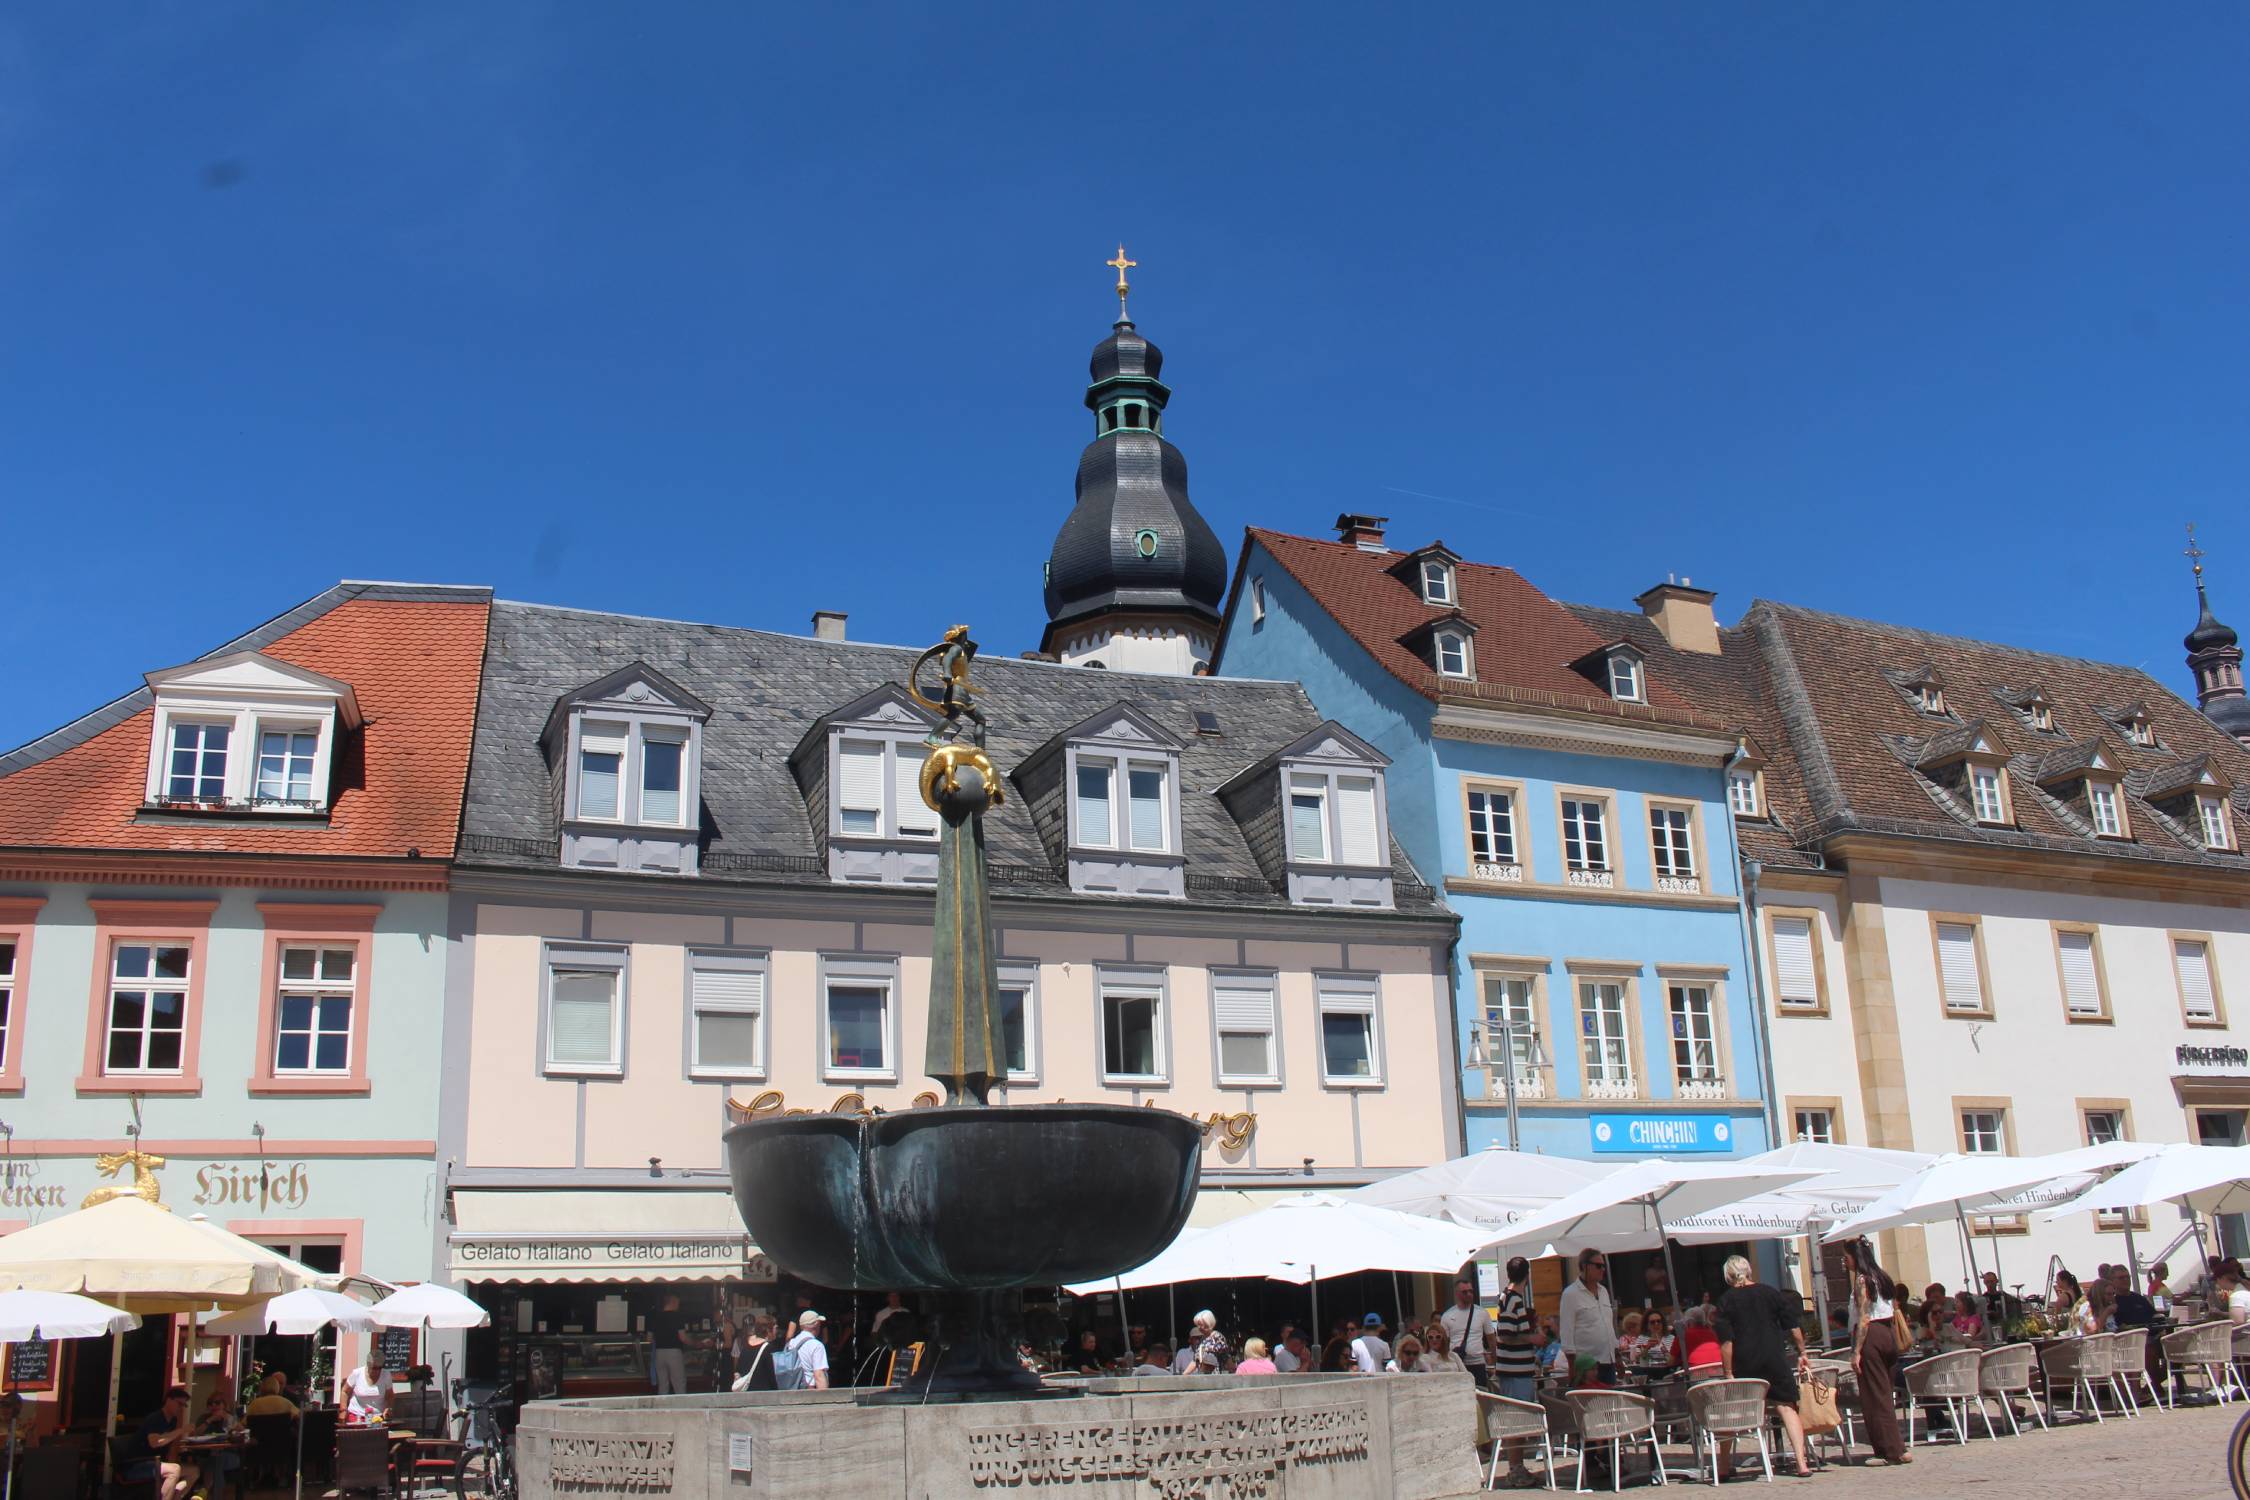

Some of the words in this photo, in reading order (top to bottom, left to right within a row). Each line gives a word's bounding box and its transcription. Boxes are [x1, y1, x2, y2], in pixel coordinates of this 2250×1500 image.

[1629, 1120, 1698, 1144] CHINCHIN
[1664, 1213, 1729, 1228] onditorei
[461, 1242, 521, 1261] Gelato
[528, 1243, 593, 1261] Italiano
[607, 1241, 665, 1260] Gelato
[671, 1241, 733, 1259] Italiano
[970, 1430, 1087, 1454] UNSEREN
[971, 1460, 1024, 1485] UND
[1027, 1457, 1077, 1482] UNS
